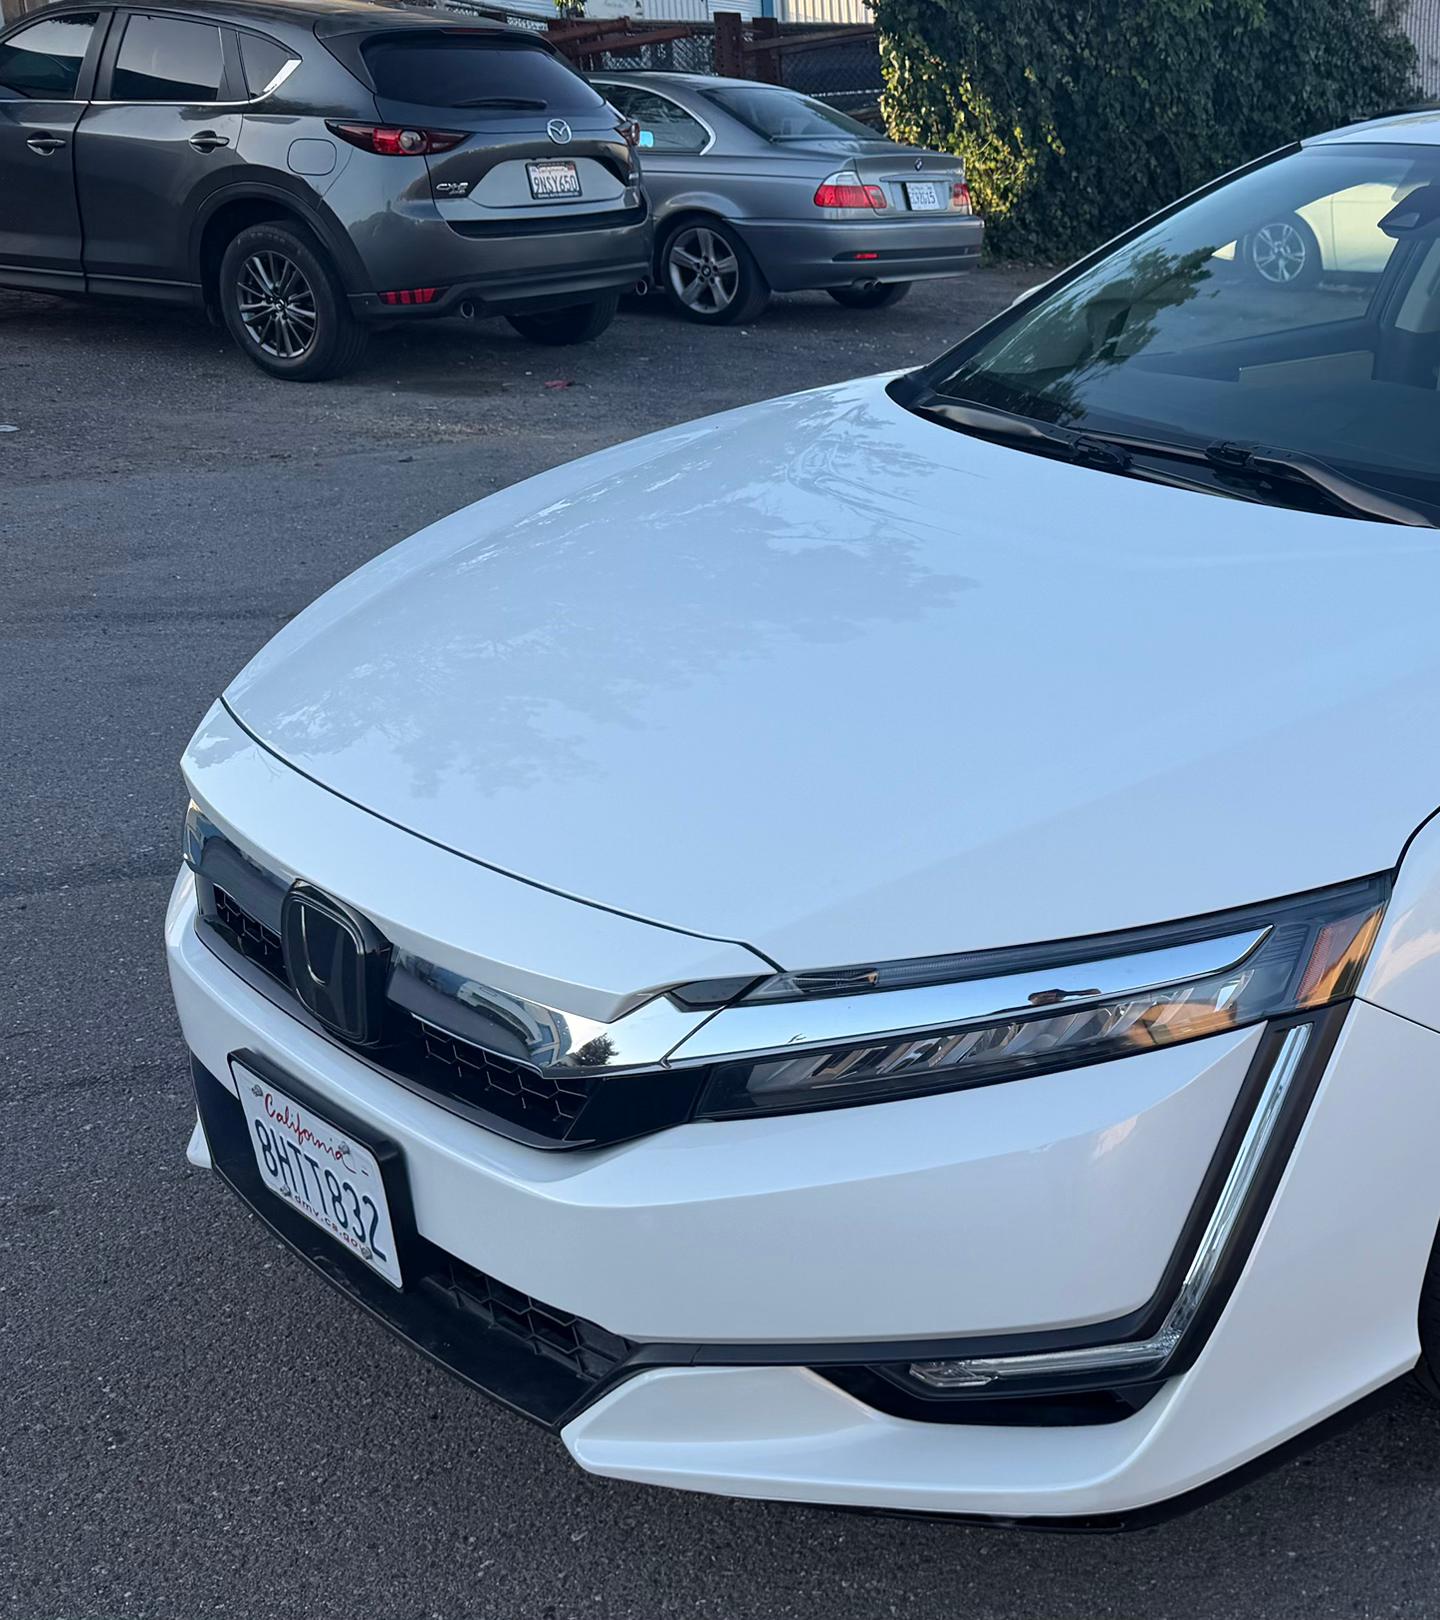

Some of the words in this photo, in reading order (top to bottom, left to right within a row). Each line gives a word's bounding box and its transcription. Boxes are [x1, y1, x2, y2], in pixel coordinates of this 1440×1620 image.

[533, 174, 579, 194] 9NSY650
[264, 1092, 347, 1165] California
[254, 1119, 388, 1263] 8HTT832
